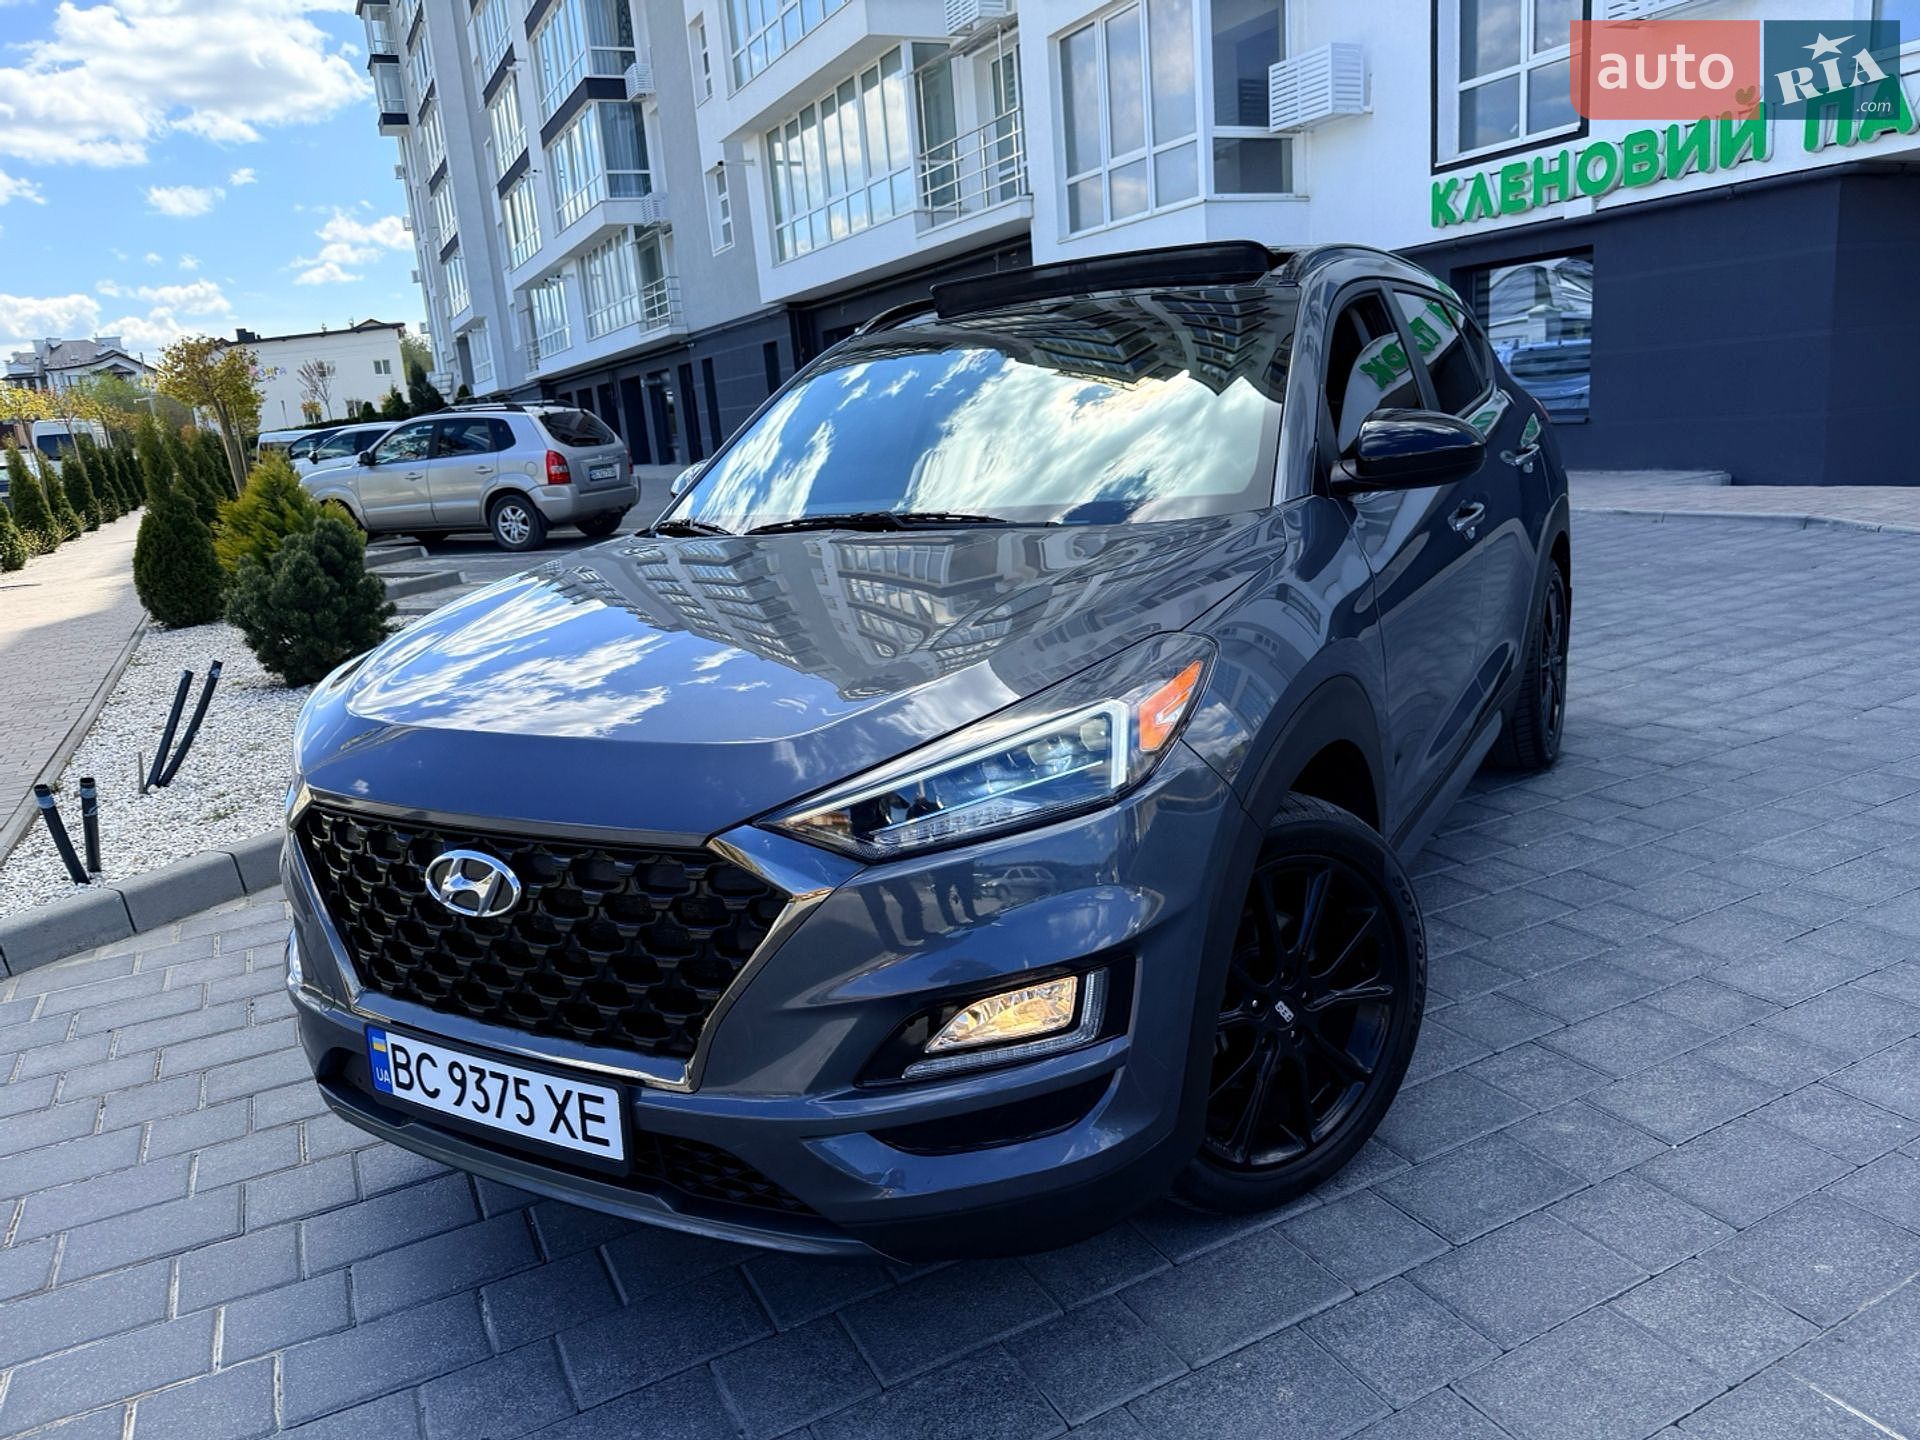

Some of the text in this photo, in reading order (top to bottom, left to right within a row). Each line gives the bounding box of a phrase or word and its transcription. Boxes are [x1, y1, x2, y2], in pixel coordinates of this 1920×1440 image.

[1431, 87, 1770, 228] КЛЕНОВИЙ
[375, 1067, 392, 1084] UA
[390, 1043, 611, 1147] BC 9375 XE
